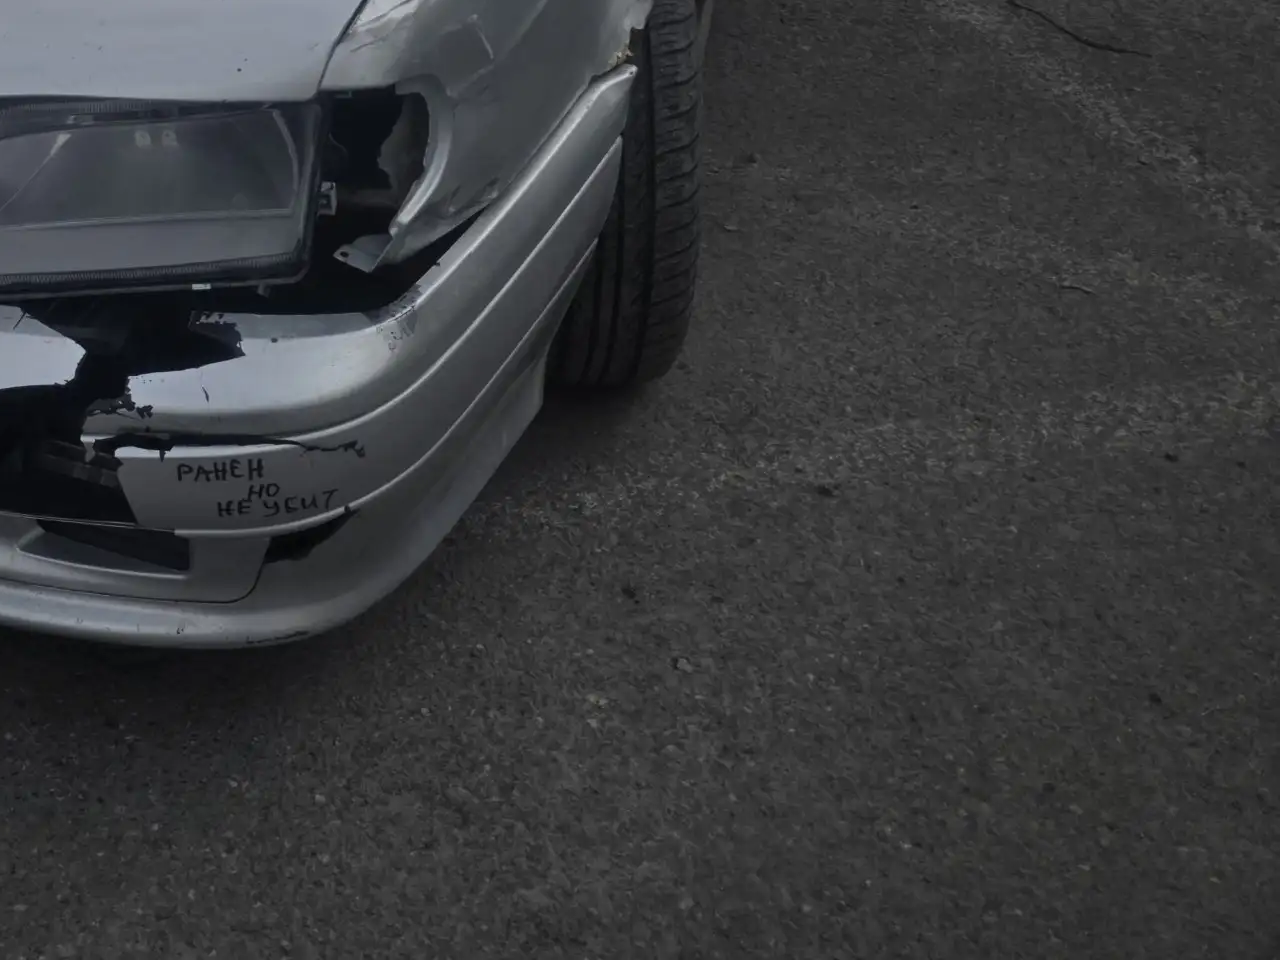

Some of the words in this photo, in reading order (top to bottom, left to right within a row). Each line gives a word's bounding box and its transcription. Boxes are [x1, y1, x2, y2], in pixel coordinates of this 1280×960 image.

[177, 458, 264, 482] РАНЕН
[247, 482, 280, 501] НО
[217, 499, 252, 517] НЕ
